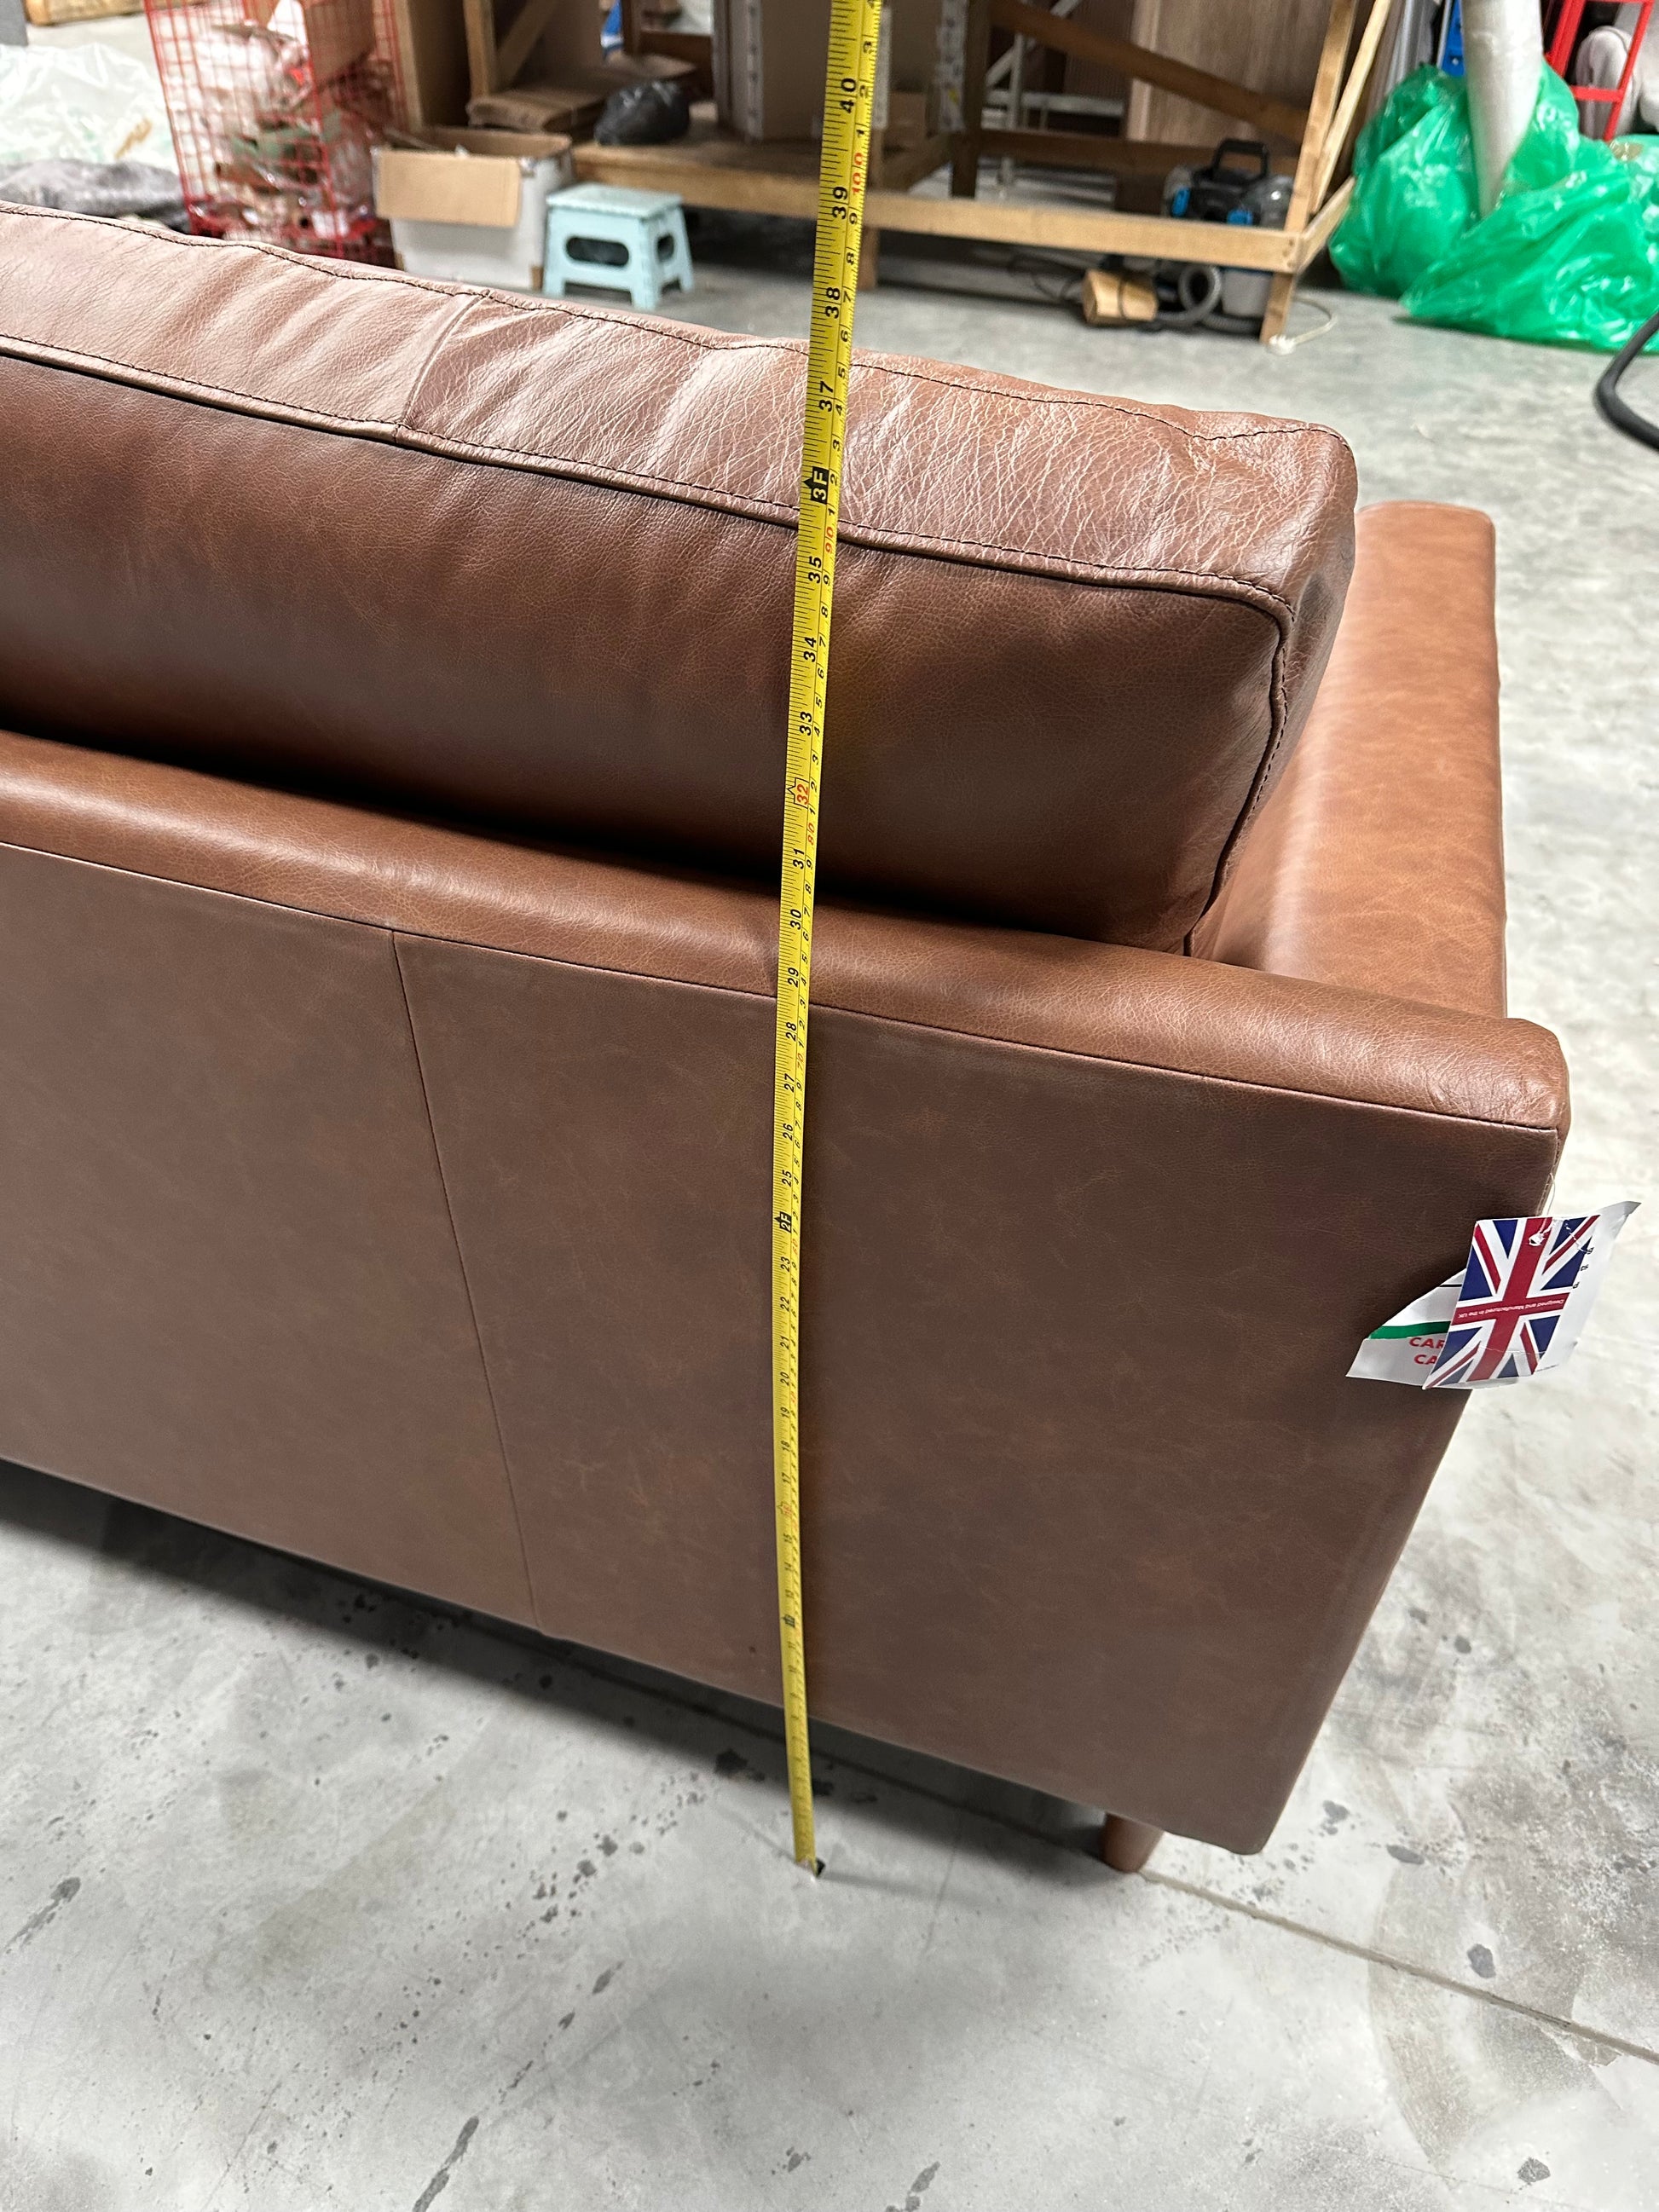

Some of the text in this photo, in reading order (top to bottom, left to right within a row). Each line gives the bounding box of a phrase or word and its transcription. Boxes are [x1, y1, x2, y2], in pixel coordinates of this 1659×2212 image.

[863, 41, 872, 55] 3
[840, 78, 856, 113] 40
[852, 153, 863, 193] 100
[832, 187, 848, 220] 39
[847, 252, 854, 265] 8
[825, 287, 840, 319] 38
[843, 291, 852, 303] 7
[841, 330, 848, 342] 6
[838, 367, 846, 378] 5
[818, 381, 833, 412] 37
[835, 405, 843, 416] 4
[832, 439, 840, 451] 3
[824, 526, 834, 554] 90
[808, 556, 821, 583] 35
[824, 575, 830, 586] 9
[821, 606, 829, 618] 8
[819, 636, 827, 648] 7
[803, 638, 816, 662] 34
[818, 667, 824, 679] 6
[816, 696, 823, 708] 5
[800, 712, 812, 736] 33
[814, 726, 820, 736] 4
[797, 784, 808, 805] 32
[793, 848, 804, 869] 31
[806, 859, 812, 869] 9
[805, 884, 812, 894] 8
[804, 907, 810, 917] 7
[790, 909, 801, 930] 30
[788, 967, 799, 987] 29
[786, 1022, 797, 1042] 28
[784, 1073, 795, 1092] 27
[783, 1123, 793, 1141] 26
[782, 1170, 791, 1187] 25
[781, 1256, 790, 1273] 23
[780, 1297, 789, 1312] 22
[1485, 1305, 1524, 1314] Manufactured
[1537, 1299, 1564, 1308] Designed
[780, 1336, 789, 1349] 21
[780, 1372, 789, 1386] 20
